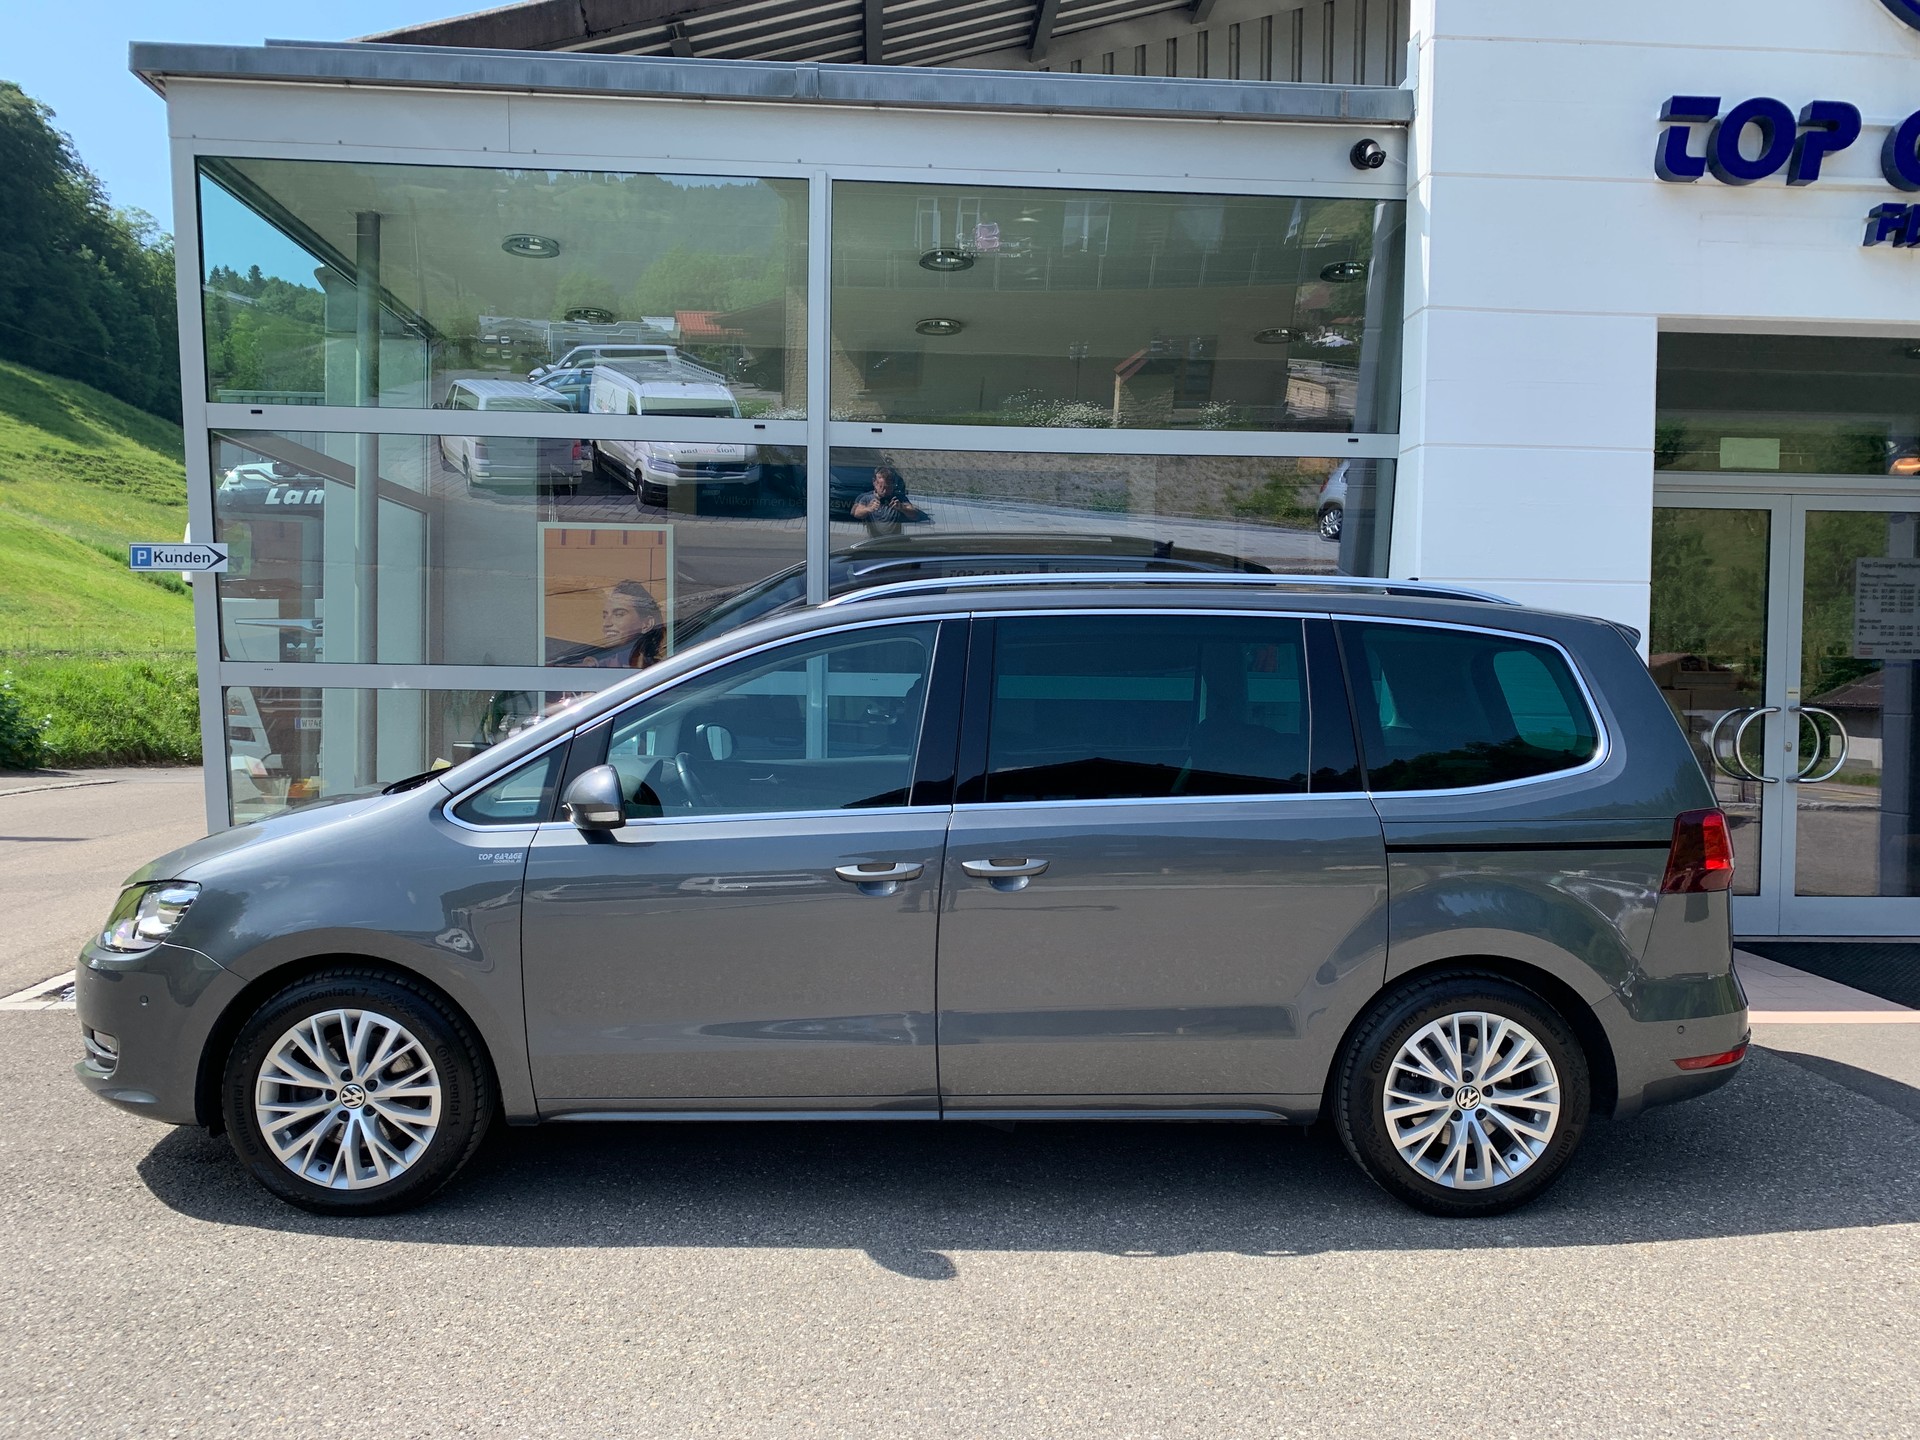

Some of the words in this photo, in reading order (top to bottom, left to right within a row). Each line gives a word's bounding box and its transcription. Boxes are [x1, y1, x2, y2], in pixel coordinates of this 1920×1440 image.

[1655, 95, 1862, 187] TOP
[153, 551, 211, 563] Kunden
[1371, 1011, 1419, 1074] Continental
[435, 1045, 461, 1116] Continental
